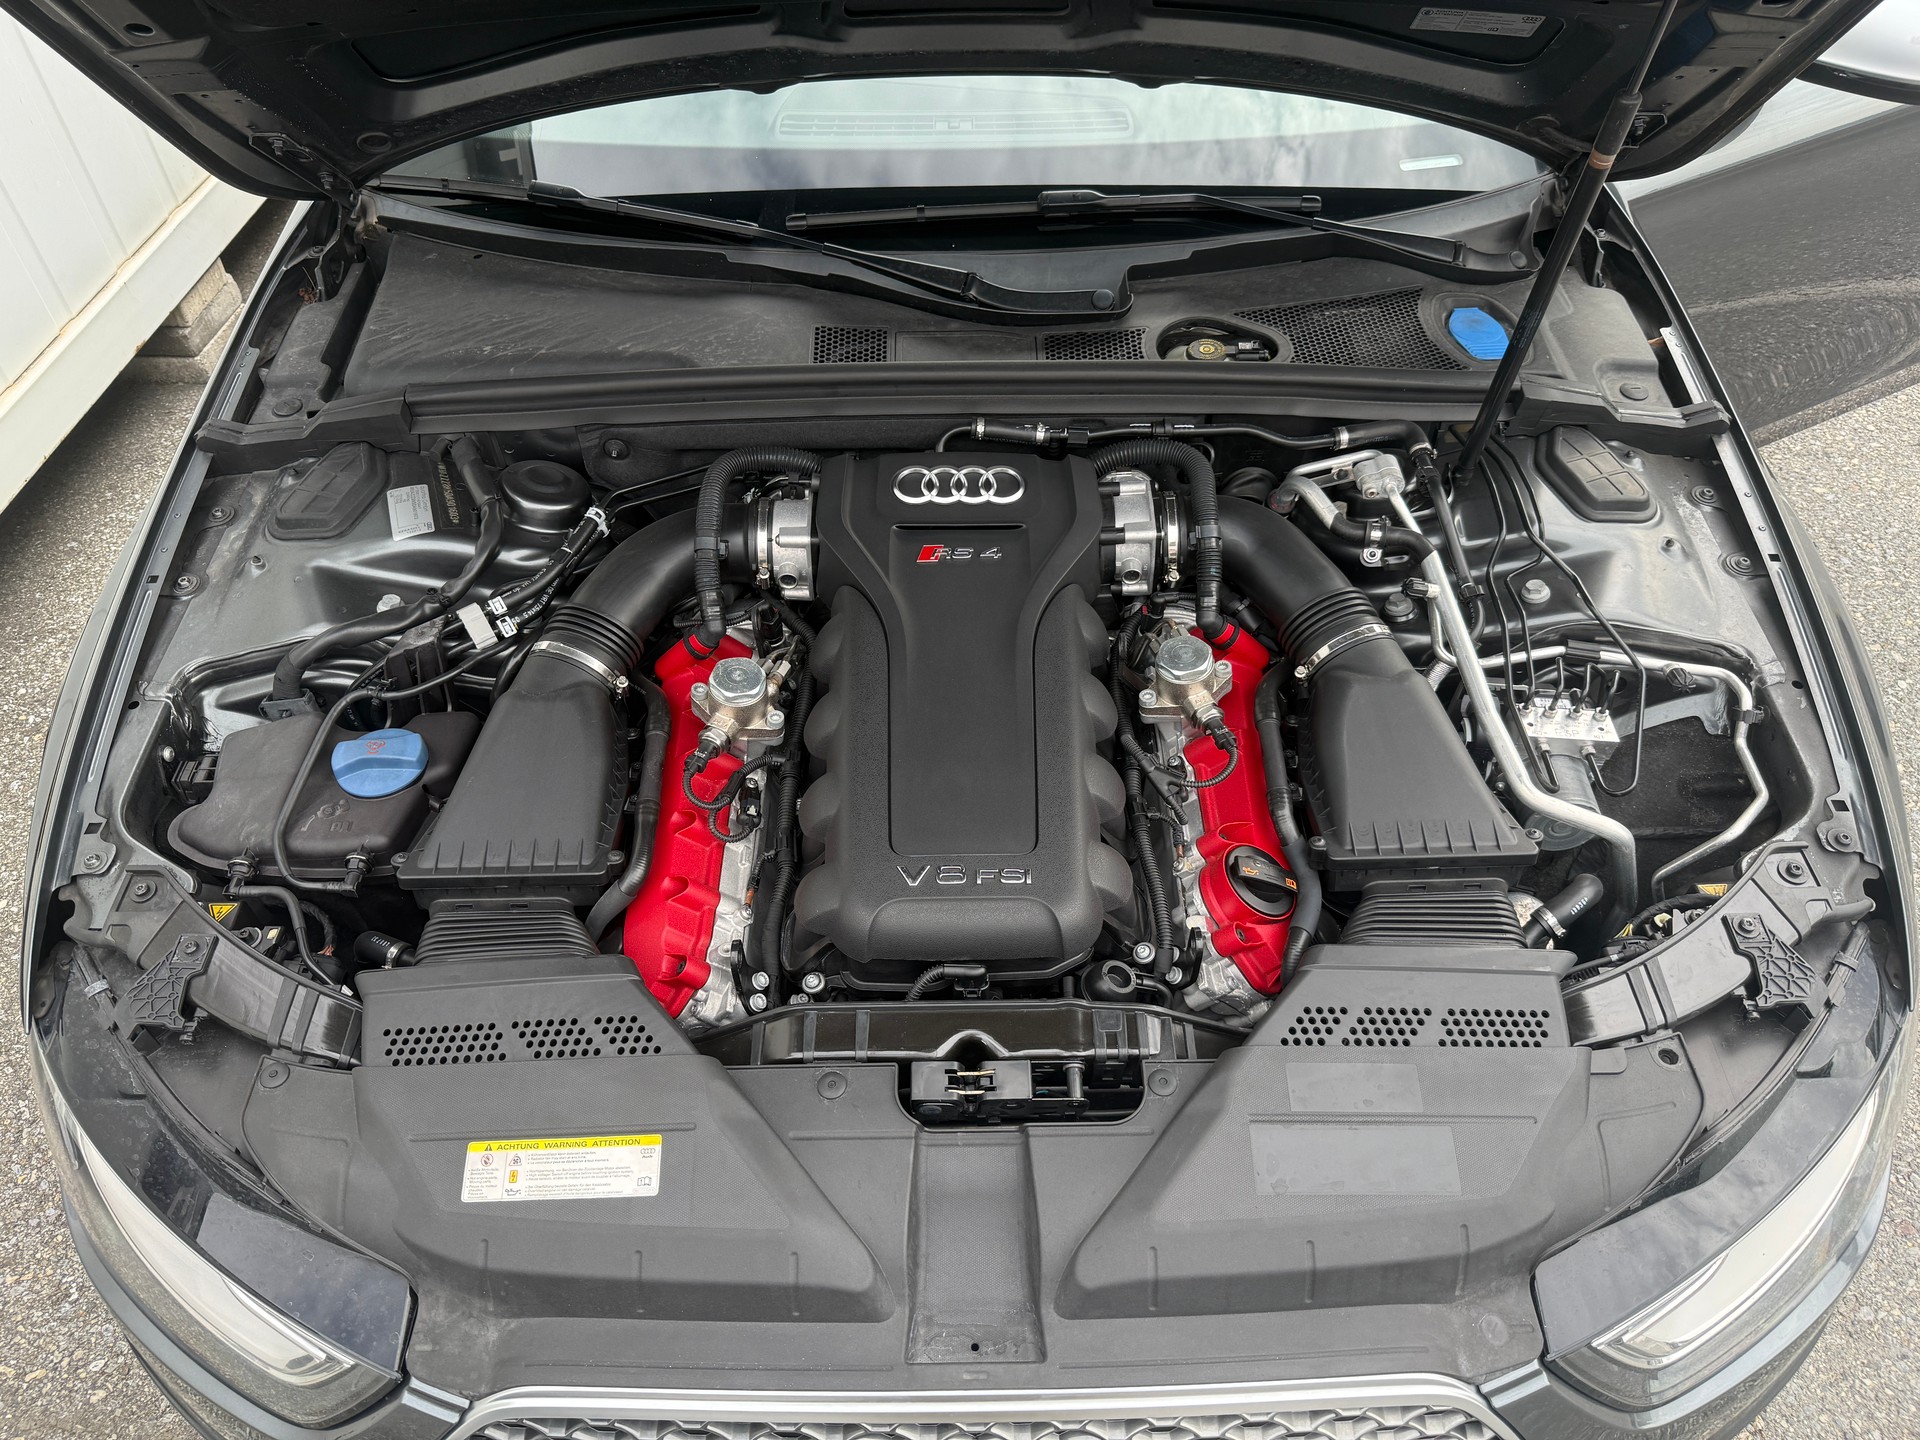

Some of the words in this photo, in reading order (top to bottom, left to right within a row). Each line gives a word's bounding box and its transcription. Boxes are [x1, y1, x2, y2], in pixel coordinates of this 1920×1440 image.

[924, 546, 974, 560] RS
[979, 546, 1002, 559] 4
[896, 864, 967, 886] V8
[976, 868, 1032, 885] FSI
[496, 1142, 539, 1151] ACHTUNG
[544, 1140, 587, 1149] WARNING
[592, 1138, 641, 1147] ATTENTION
